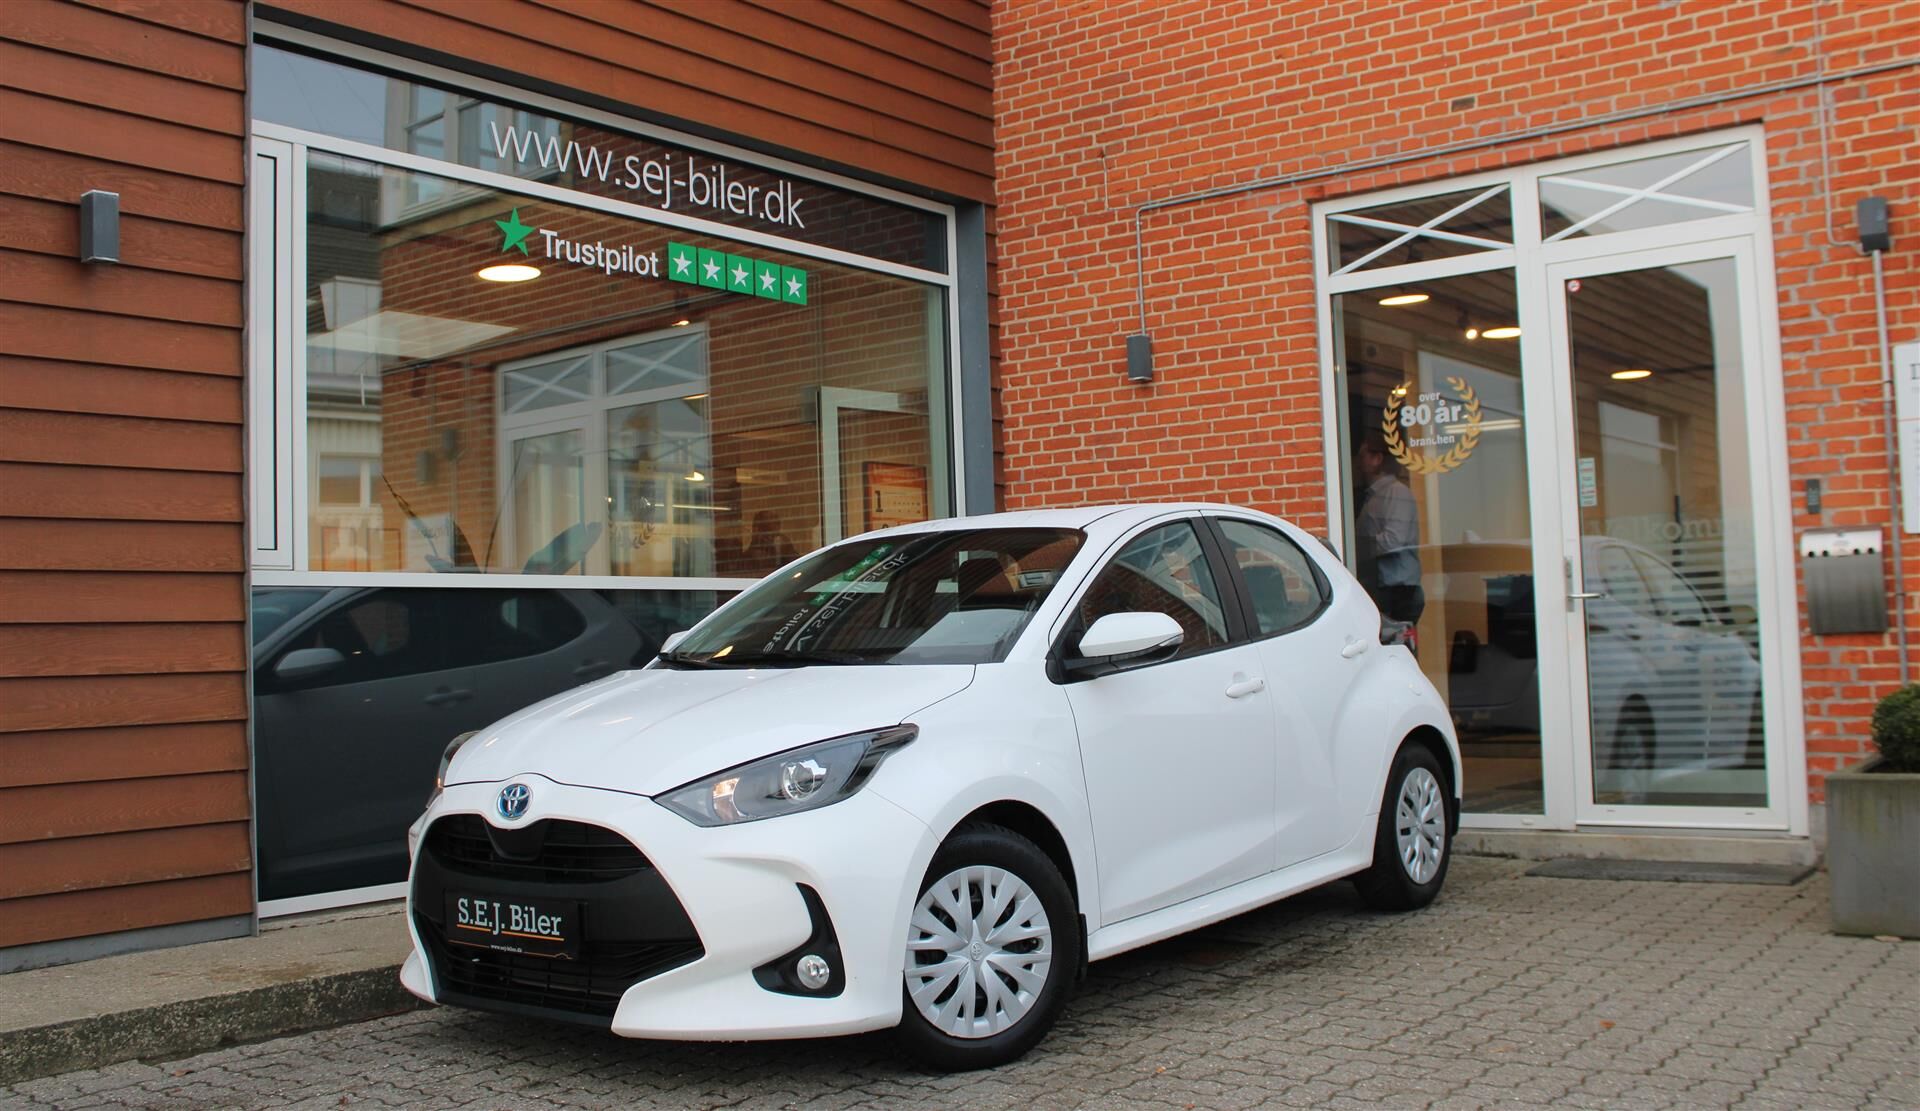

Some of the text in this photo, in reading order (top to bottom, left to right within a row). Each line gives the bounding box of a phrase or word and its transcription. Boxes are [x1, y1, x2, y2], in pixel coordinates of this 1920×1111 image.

[490, 121, 805, 228] www.sej-biler.dk
[540, 228, 659, 278] Trustpilot
[1400, 400, 1462, 427] 80 år
[1419, 392, 1441, 402] over
[457, 898, 562, 936] S.E.J. Biler
